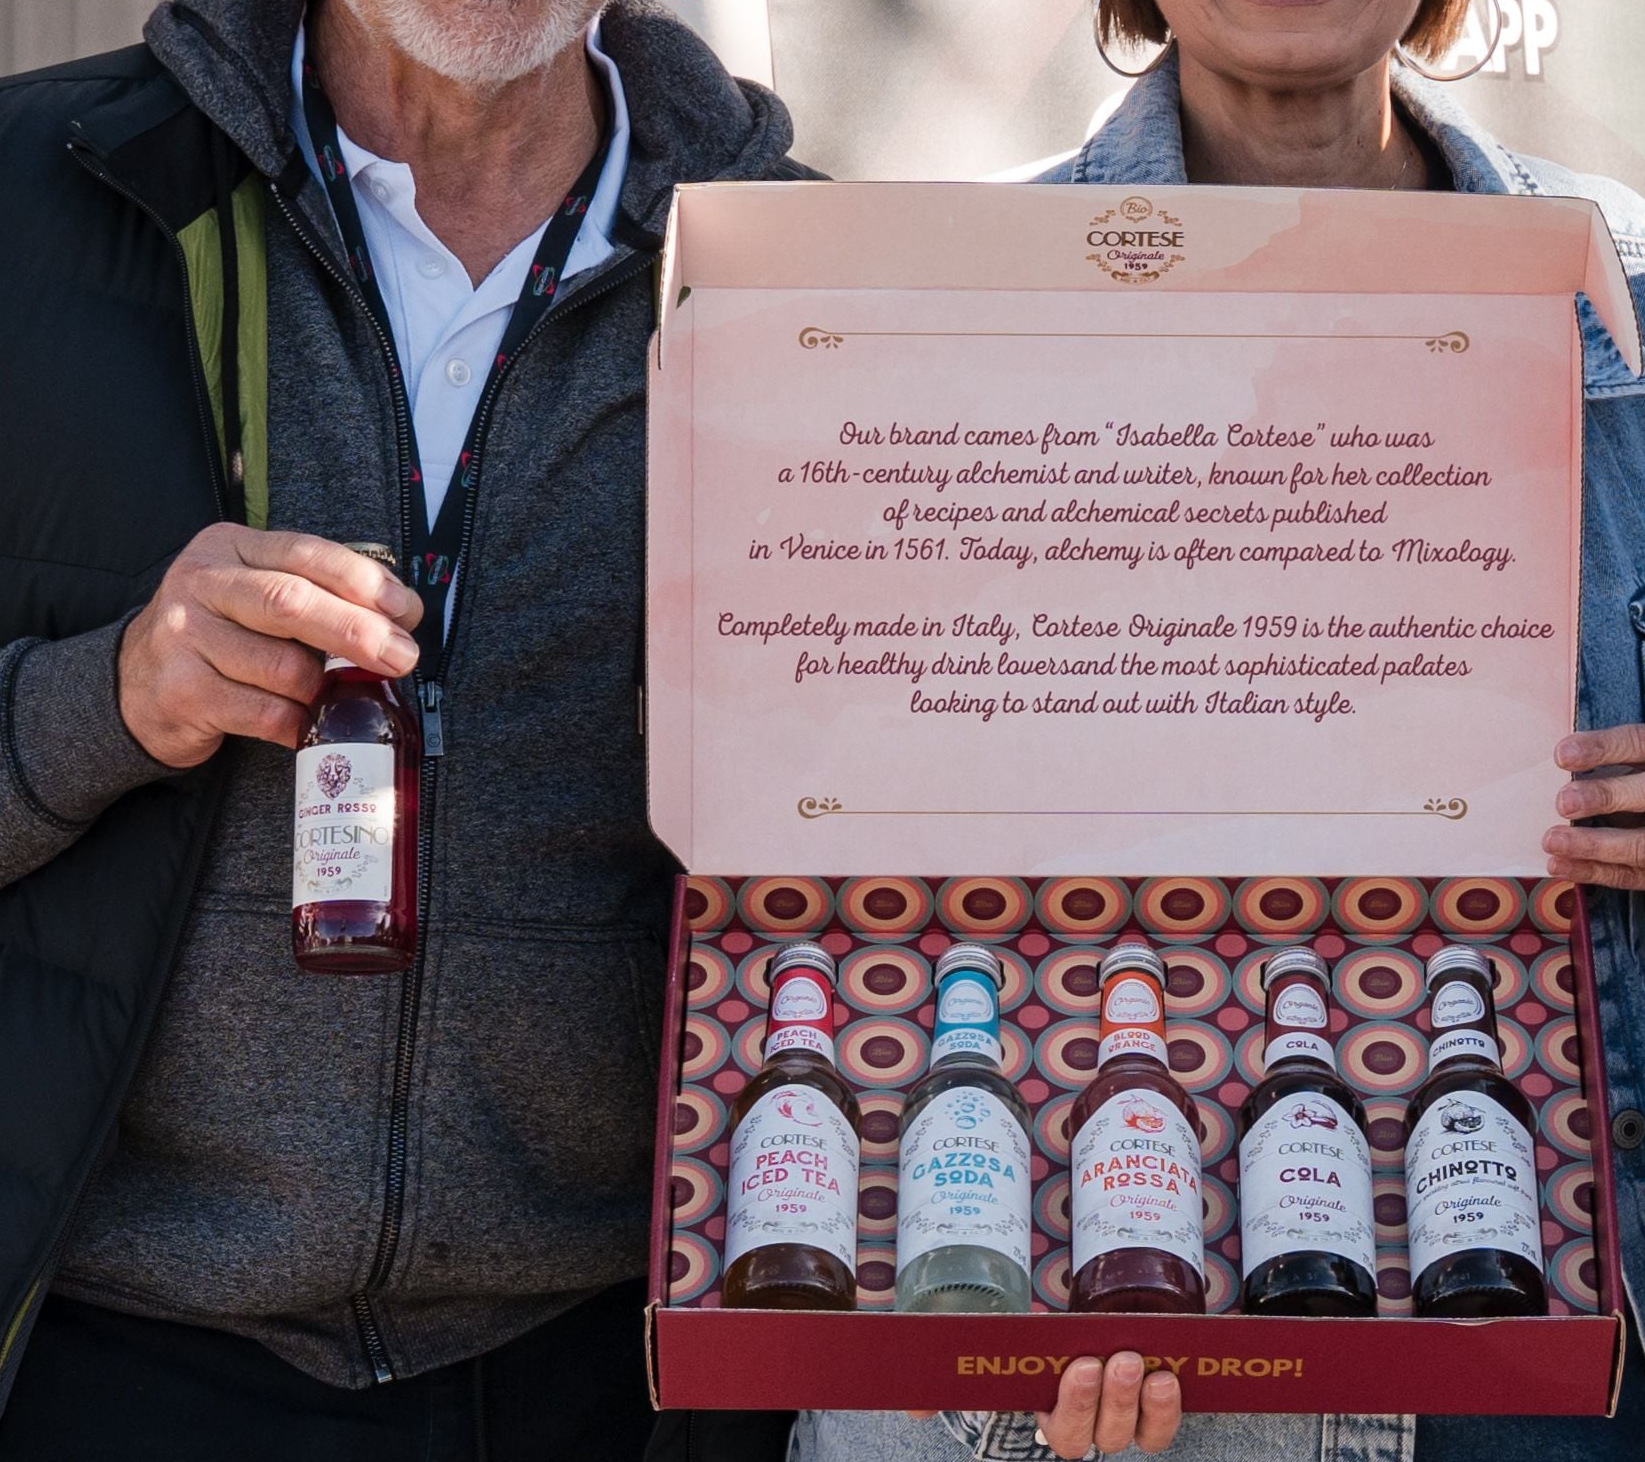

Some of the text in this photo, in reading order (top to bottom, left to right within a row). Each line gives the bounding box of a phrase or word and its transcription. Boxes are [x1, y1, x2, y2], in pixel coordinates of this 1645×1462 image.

[1087, 231, 1185, 247] CORTESE
[1107, 250, 1165, 262] Originale
[840, 422, 885, 445] Our
[890, 422, 960, 445] brand
[1041, 423, 1100, 455] from
[1330, 425, 1381, 447] who
[1385, 432, 1435, 448] was
[778, 460, 1492, 494] a 16th-century alchemist and writer, known for her collection
[883, 499, 1388, 532] of recipes and alchemical secrets published
[749, 540, 772, 559] in
[780, 533, 862, 560] Venice
[865, 540, 888, 560] in
[960, 537, 1037, 569] Today,
[1045, 538, 1145, 570] alchemy
[1148, 541, 1170, 561] is
[1174, 538, 1235, 570] often
[1239, 539, 1355, 570] compared
[1360, 540, 1384, 561] to
[718, 613, 1555, 646] Completely made in Italy, Cortese Originale 1959 is the authentic choice
[795, 651, 834, 683] for
[837, 652, 928, 684] healthy
[932, 652, 993, 675] drink
[1121, 652, 1158, 675] the
[1161, 653, 1220, 675] most
[1224, 653, 1379, 684] sophisticated
[1381, 653, 1472, 685] palates
[911, 690, 1355, 723] looking to stand out with Italian style.
[298, 803, 377, 818] GINGER ROSSO
[294, 826, 388, 851] CORTESINO
[304, 847, 361, 865] Originale
[317, 866, 341, 877] 1959
[761, 1134, 828, 1150] CORTESE
[933, 1136, 999, 1153] CORTESE
[1110, 1139, 1176, 1157] CORTESE
[1279, 1142, 1344, 1160] CORTESE
[1431, 1140, 1497, 1160] CORTESE
[756, 1150, 828, 1170] PEACH
[913, 1153, 1016, 1182] GAZZOSA
[742, 1168, 840, 1195] ICED TEA
[934, 1169, 994, 1188] SODA
[1081, 1156, 1198, 1195] ARANCIATA
[1103, 1172, 1181, 1196] ROSSA
[1280, 1168, 1341, 1188] COLA
[1416, 1160, 1517, 1195] CHINOTTO
[758, 1187, 826, 1204] Originale
[931, 1190, 998, 1205] Originale
[1110, 1194, 1177, 1211] Originale
[1279, 1195, 1346, 1213] Originale
[1435, 1194, 1502, 1215] Originale
[776, 1204, 807, 1213] 1959
[949, 1206, 980, 1215] 1959
[1130, 1211, 1160, 1221] 1959
[1299, 1212, 1329, 1222] 1959
[1453, 1212, 1484, 1223] 1959
[957, 1355, 1070, 1375] ENJOY
[1197, 1357, 1304, 1378] DROP!
